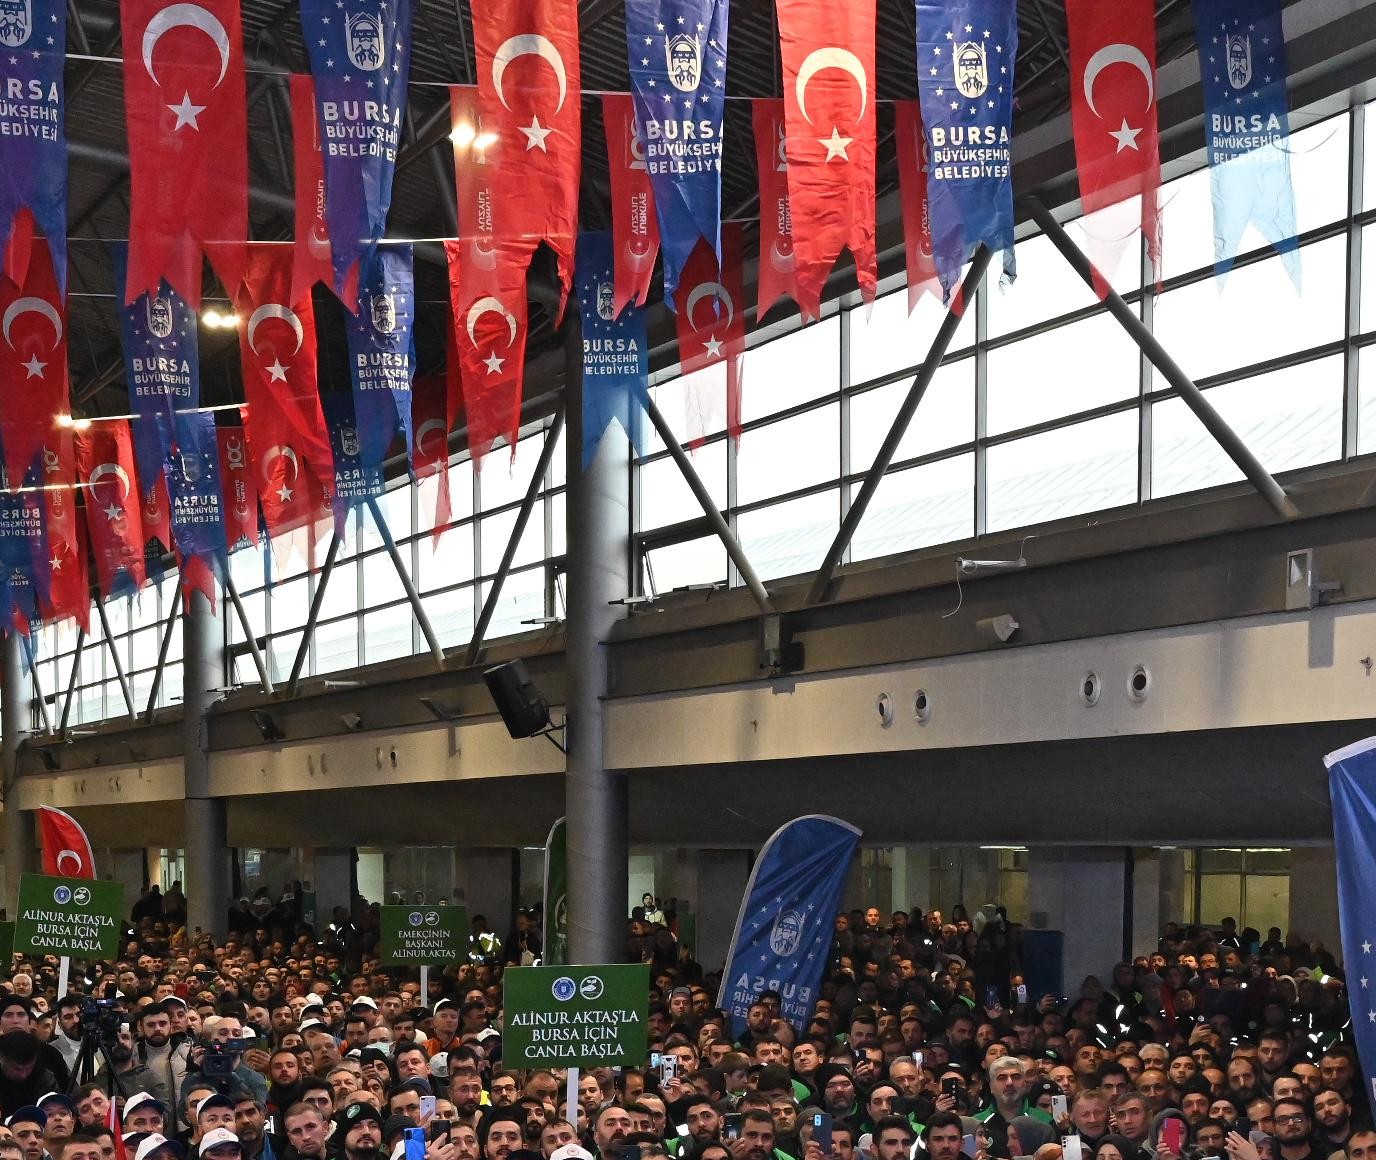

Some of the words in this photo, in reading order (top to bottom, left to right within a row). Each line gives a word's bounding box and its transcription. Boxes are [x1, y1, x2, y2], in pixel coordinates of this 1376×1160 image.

[323, 101, 400, 128] BURSA
[1212, 113, 1280, 133] BURSA
[932, 125, 1009, 147] BURSA
[647, 140, 723, 157] BÜYÜKŞEH
[584, 339, 638, 352] BURSA
[132, 357, 190, 373] BURSA
[357, 353, 409, 369] BURSA
[23, 908, 66, 922] ALİNUR
[37, 923, 71, 935] BURSA
[74, 924, 99, 938] İÇİN
[398, 929, 450, 939] EMEKÇİNİN
[30, 936, 68, 948] CANLA
[71, 938, 103, 952] BAŞLA
[405, 939, 444, 950] BAŞKANI
[392, 947, 429, 958] ALİNUR
[428, 949, 456, 959] AKTAŞ
[511, 1010, 571, 1026] ALİNUR
[573, 1010, 639, 1026] AKTAŞ'LA
[532, 1028, 580, 1042] BURSA
[584, 1025, 618, 1043] İÇİN
[525, 1045, 577, 1059] CANLA
[580, 1043, 624, 1060] BAŞLA
